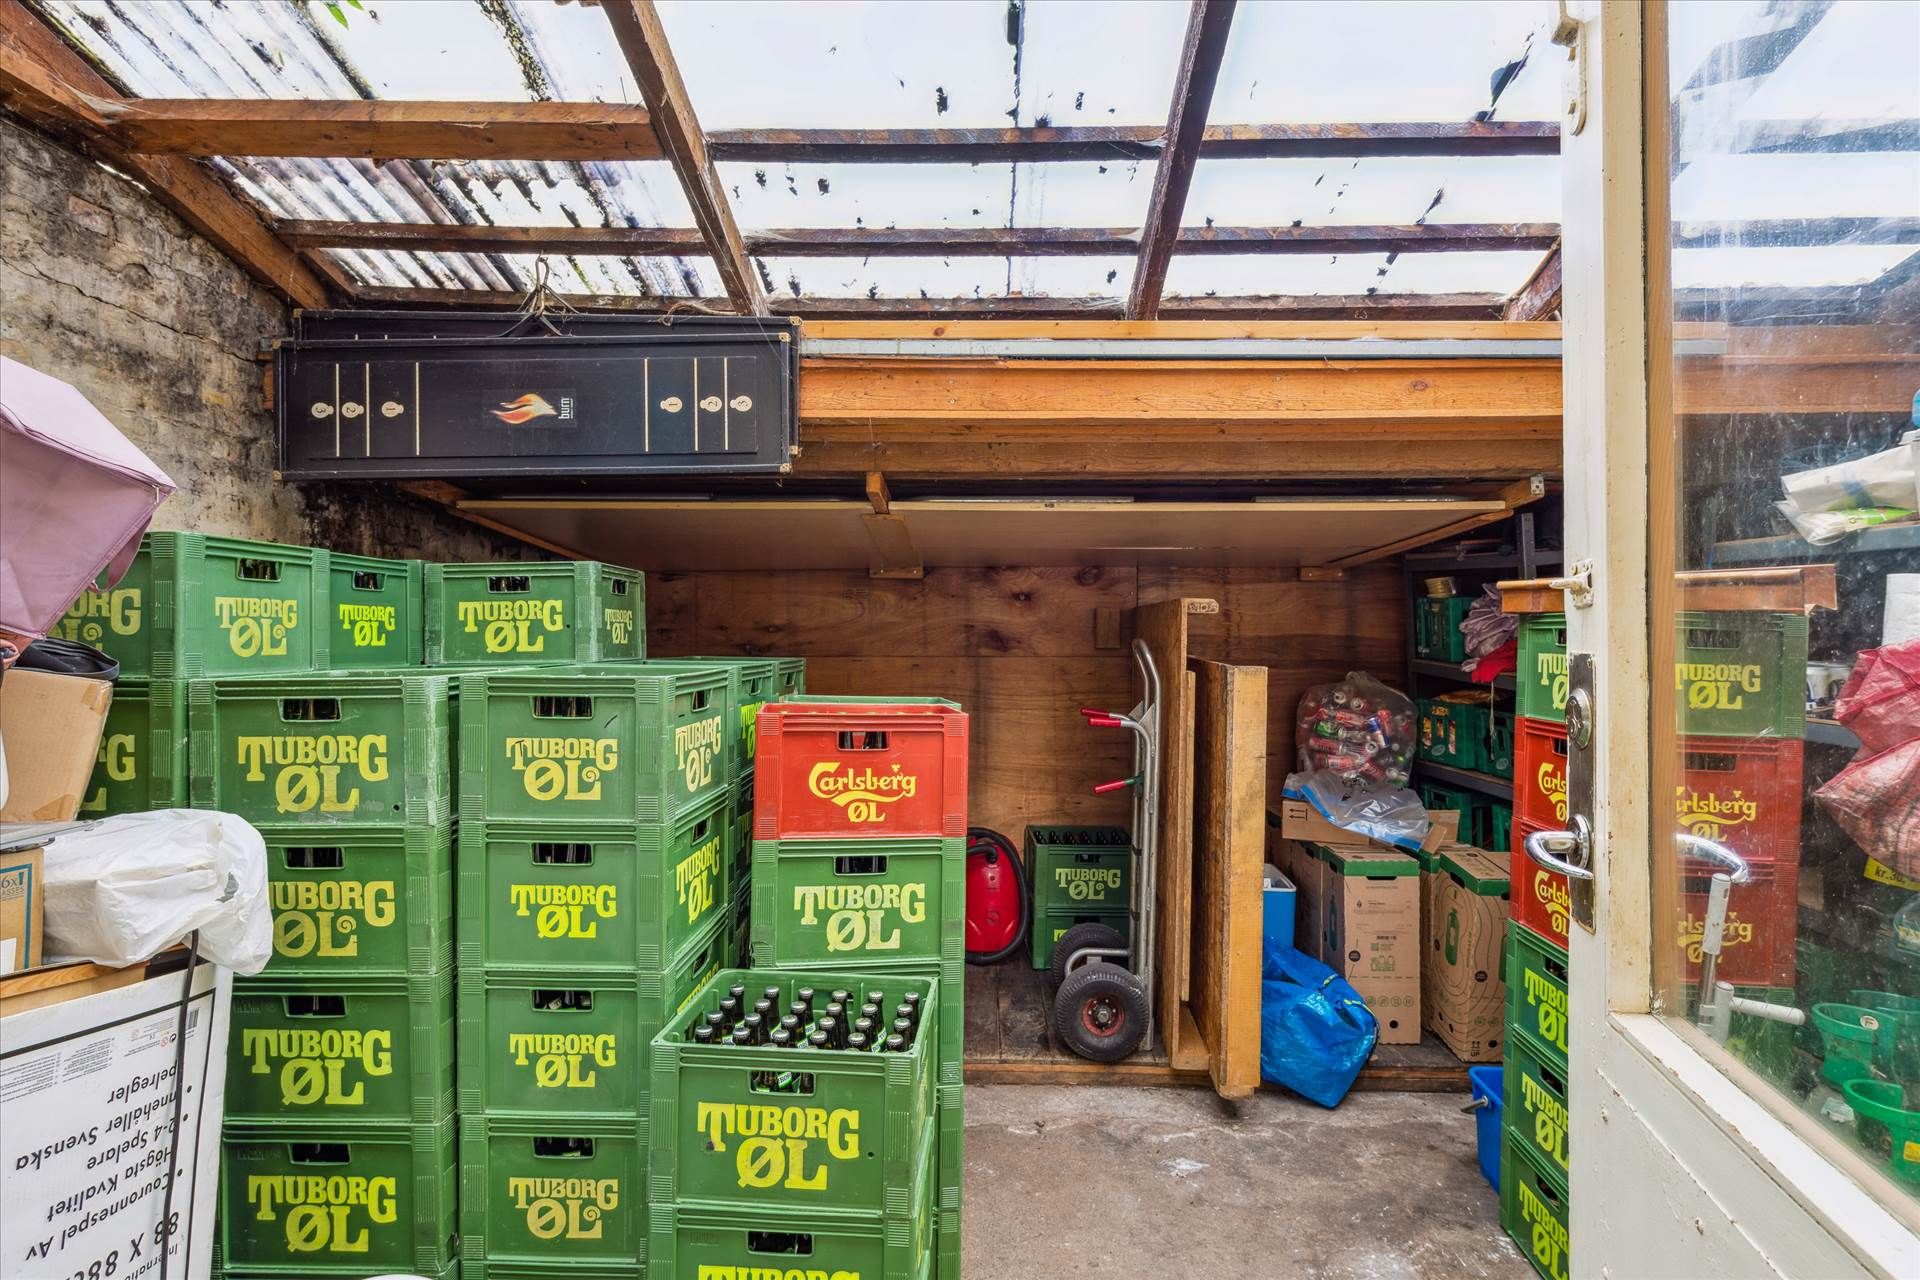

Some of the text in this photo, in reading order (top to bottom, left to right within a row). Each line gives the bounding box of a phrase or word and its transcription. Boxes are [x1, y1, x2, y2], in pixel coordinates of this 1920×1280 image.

[558, 397, 570, 419] burn
[66, 588, 142, 635] ORG
[215, 597, 297, 629] TUBORG
[340, 604, 395, 630] TUBORG
[458, 600, 563, 631] TUBORG
[605, 608, 632, 631] TUBORG
[230, 617, 286, 657] ØL
[354, 623, 385, 647] ØL
[485, 620, 544, 653] ØL
[1552, 674, 1569, 710] Ø
[1688, 680, 1742, 710] ØL
[238, 734, 389, 782] TUBORG
[506, 737, 618, 773] TUBORG
[676, 716, 721, 770] TUBORG
[275, 764, 359, 814] ØL
[523, 757, 602, 801] ØL
[686, 747, 711, 793] ØL
[808, 762, 917, 798] Carlsberg
[1538, 762, 1567, 795] Carls
[848, 802, 887, 823] ØL
[1556, 802, 1568, 822] Ø
[1676, 786, 1757, 822] rlsberg
[676, 836, 720, 905] TUBORG
[1055, 868, 1121, 889] TUBORG
[1069, 880, 1105, 900] ØL
[1533, 869, 1571, 904] Carlsb
[270, 881, 395, 927] UBORG
[511, 884, 617, 918] TUBORG
[688, 870, 713, 924] ØL
[794, 883, 926, 925] TUBORG
[273, 910, 358, 957] ØL
[537, 906, 596, 939] ØL
[826, 909, 901, 952] ØL
[1525, 967, 1569, 1015] TUBO
[244, 1029, 392, 1076] TUBORG
[510, 1034, 616, 1067] TUBORG
[107, 1059, 178, 1104] pelregler
[281, 1058, 364, 1106] ØL
[536, 1057, 596, 1088] ØL
[1521, 1072, 1569, 1132] TUBOR
[16, 1091, 177, 1171] nnehåller Svenska
[87, 1128, 148, 1170] Spelare
[698, 1102, 860, 1160] TUBORG
[47, 1146, 172, 1223] Högsta Kvalitet
[736, 1138, 827, 1191] ØL
[249, 1175, 397, 1224] TUBORG
[509, 1176, 619, 1211] TUBORG
[25, 1172, 170, 1262] Couronnespel Av
[286, 1204, 369, 1253] ØL
[526, 1198, 602, 1240] ØL
[1519, 1179, 1569, 1254] TUBOR
[129, 1232, 144, 1262] X
